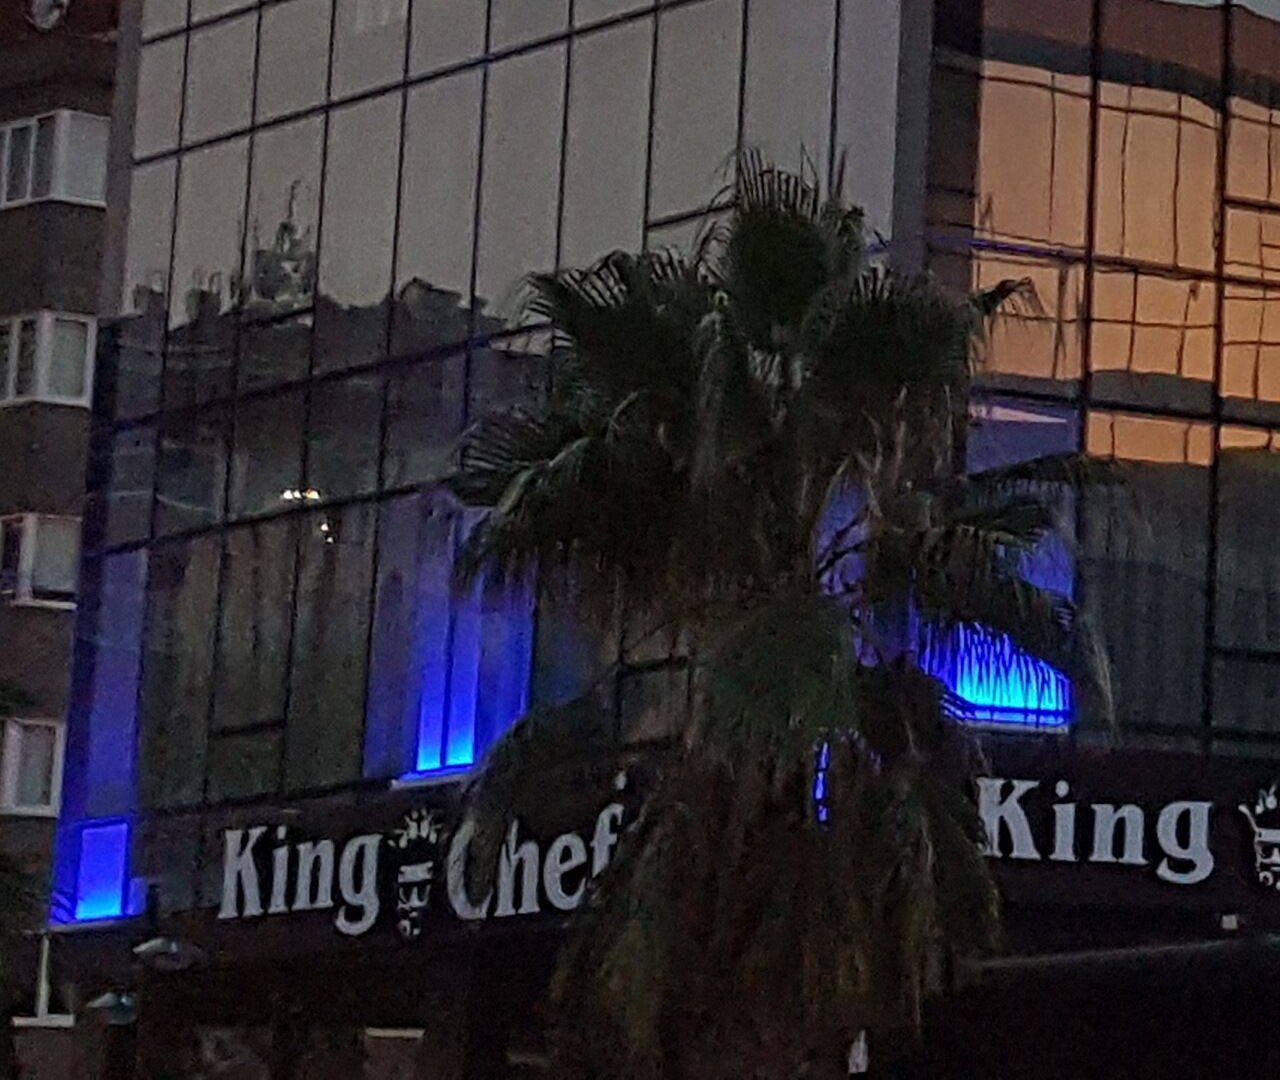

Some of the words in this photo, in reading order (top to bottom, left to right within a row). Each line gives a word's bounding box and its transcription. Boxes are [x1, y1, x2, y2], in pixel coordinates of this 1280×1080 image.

[217, 824, 384, 935] King
[445, 801, 626, 921] Chef
[974, 776, 1214, 885] King
